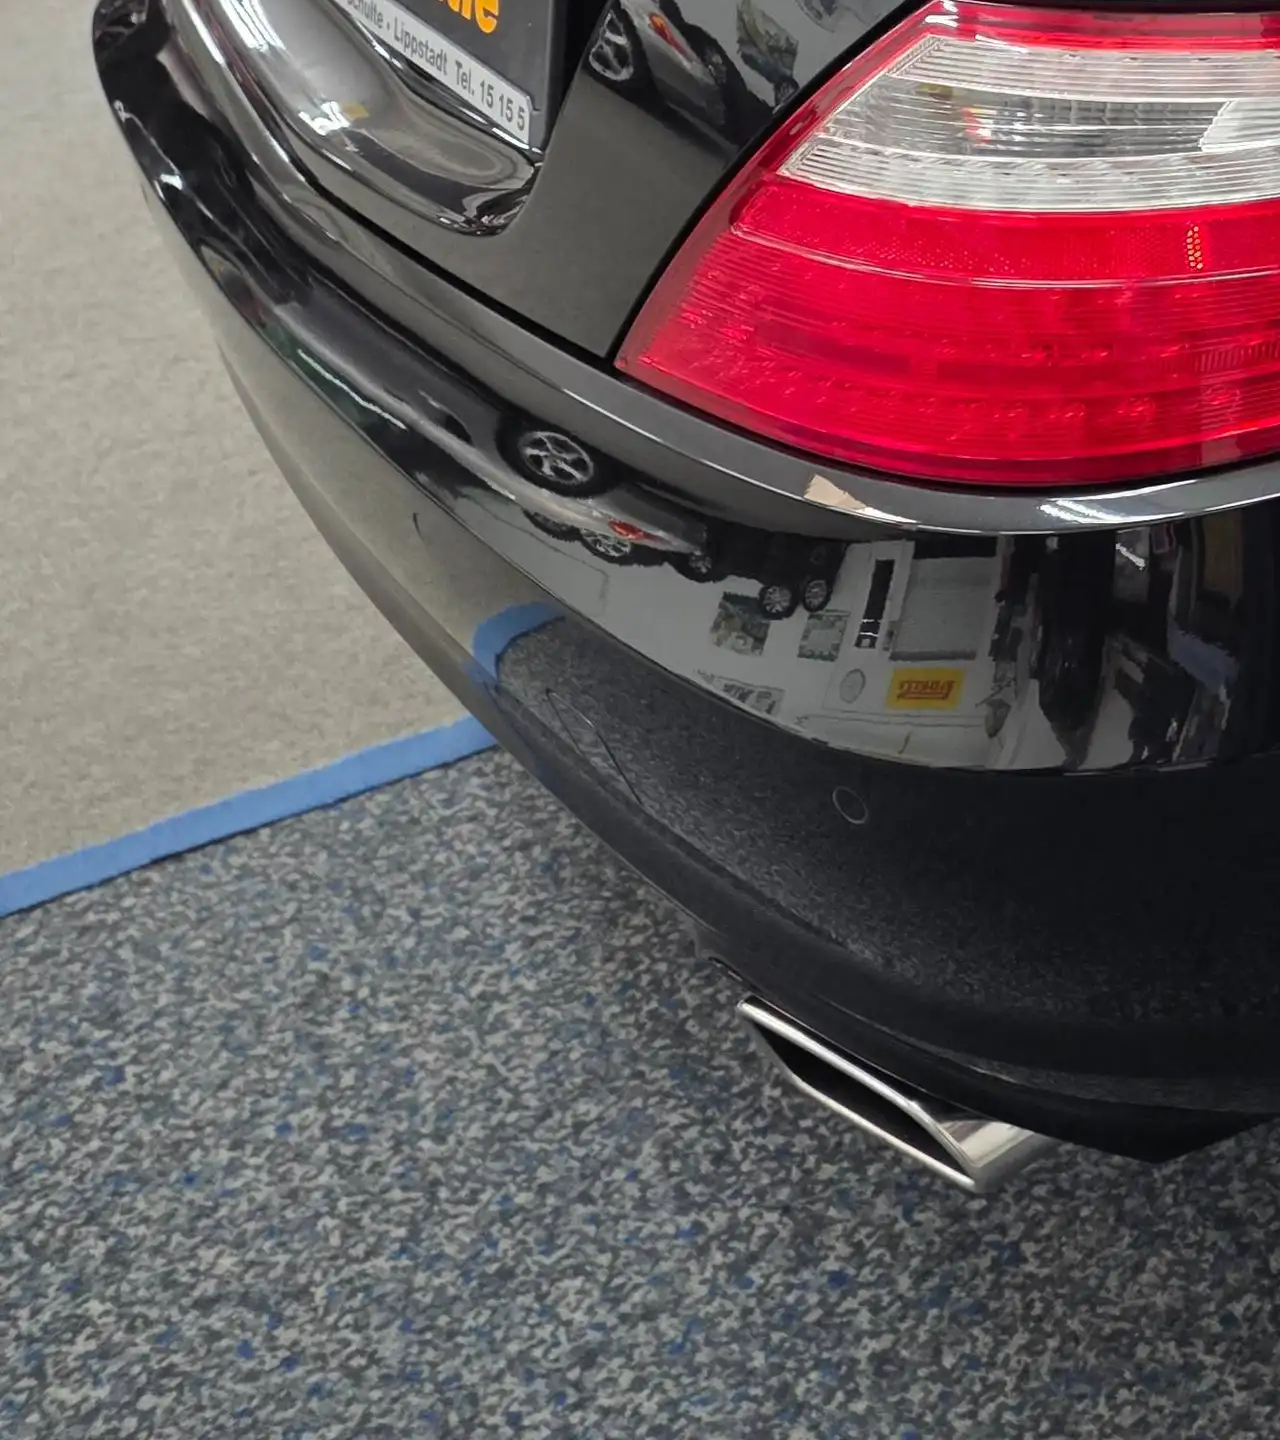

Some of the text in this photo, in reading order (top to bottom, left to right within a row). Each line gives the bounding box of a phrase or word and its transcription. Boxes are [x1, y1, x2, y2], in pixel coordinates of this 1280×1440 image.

[394, 16, 448, 76] Lippstadt
[455, 59, 475, 96] Tel.
[480, 79, 495, 110] 15
[498, 94, 514, 124] 15
[516, 105, 526, 132] 5
